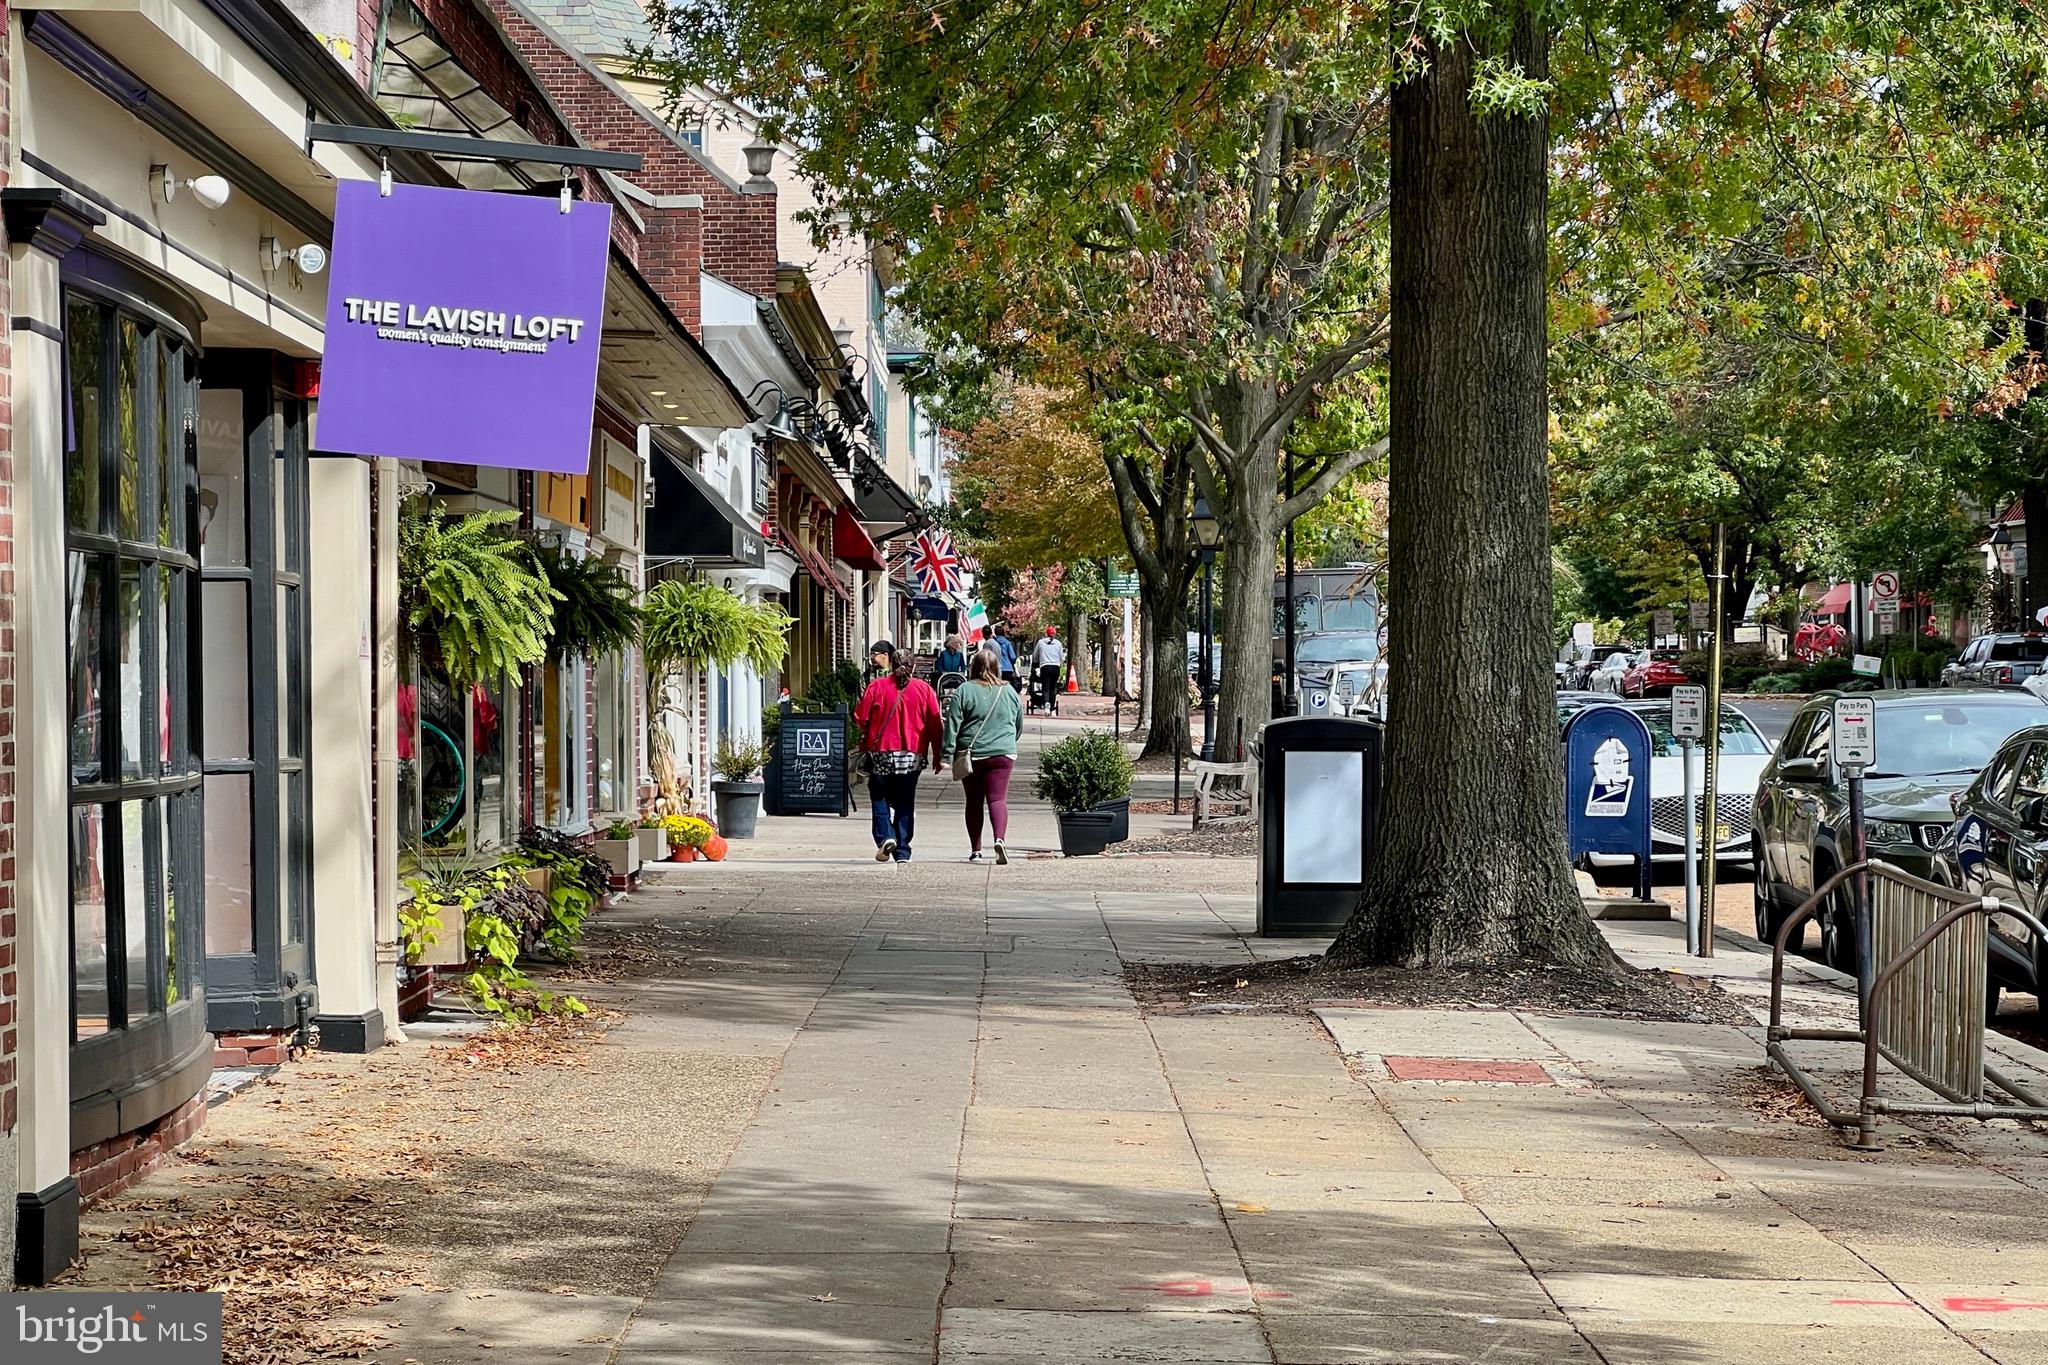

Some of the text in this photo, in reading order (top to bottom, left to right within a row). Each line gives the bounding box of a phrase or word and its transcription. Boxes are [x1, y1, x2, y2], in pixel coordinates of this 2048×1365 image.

[344, 297, 584, 342] THE LAVISH LOFT
[377, 326, 548, 354] women's quality consignment
[1839, 702, 1850, 711] Pay
[801, 733, 825, 748] RA
